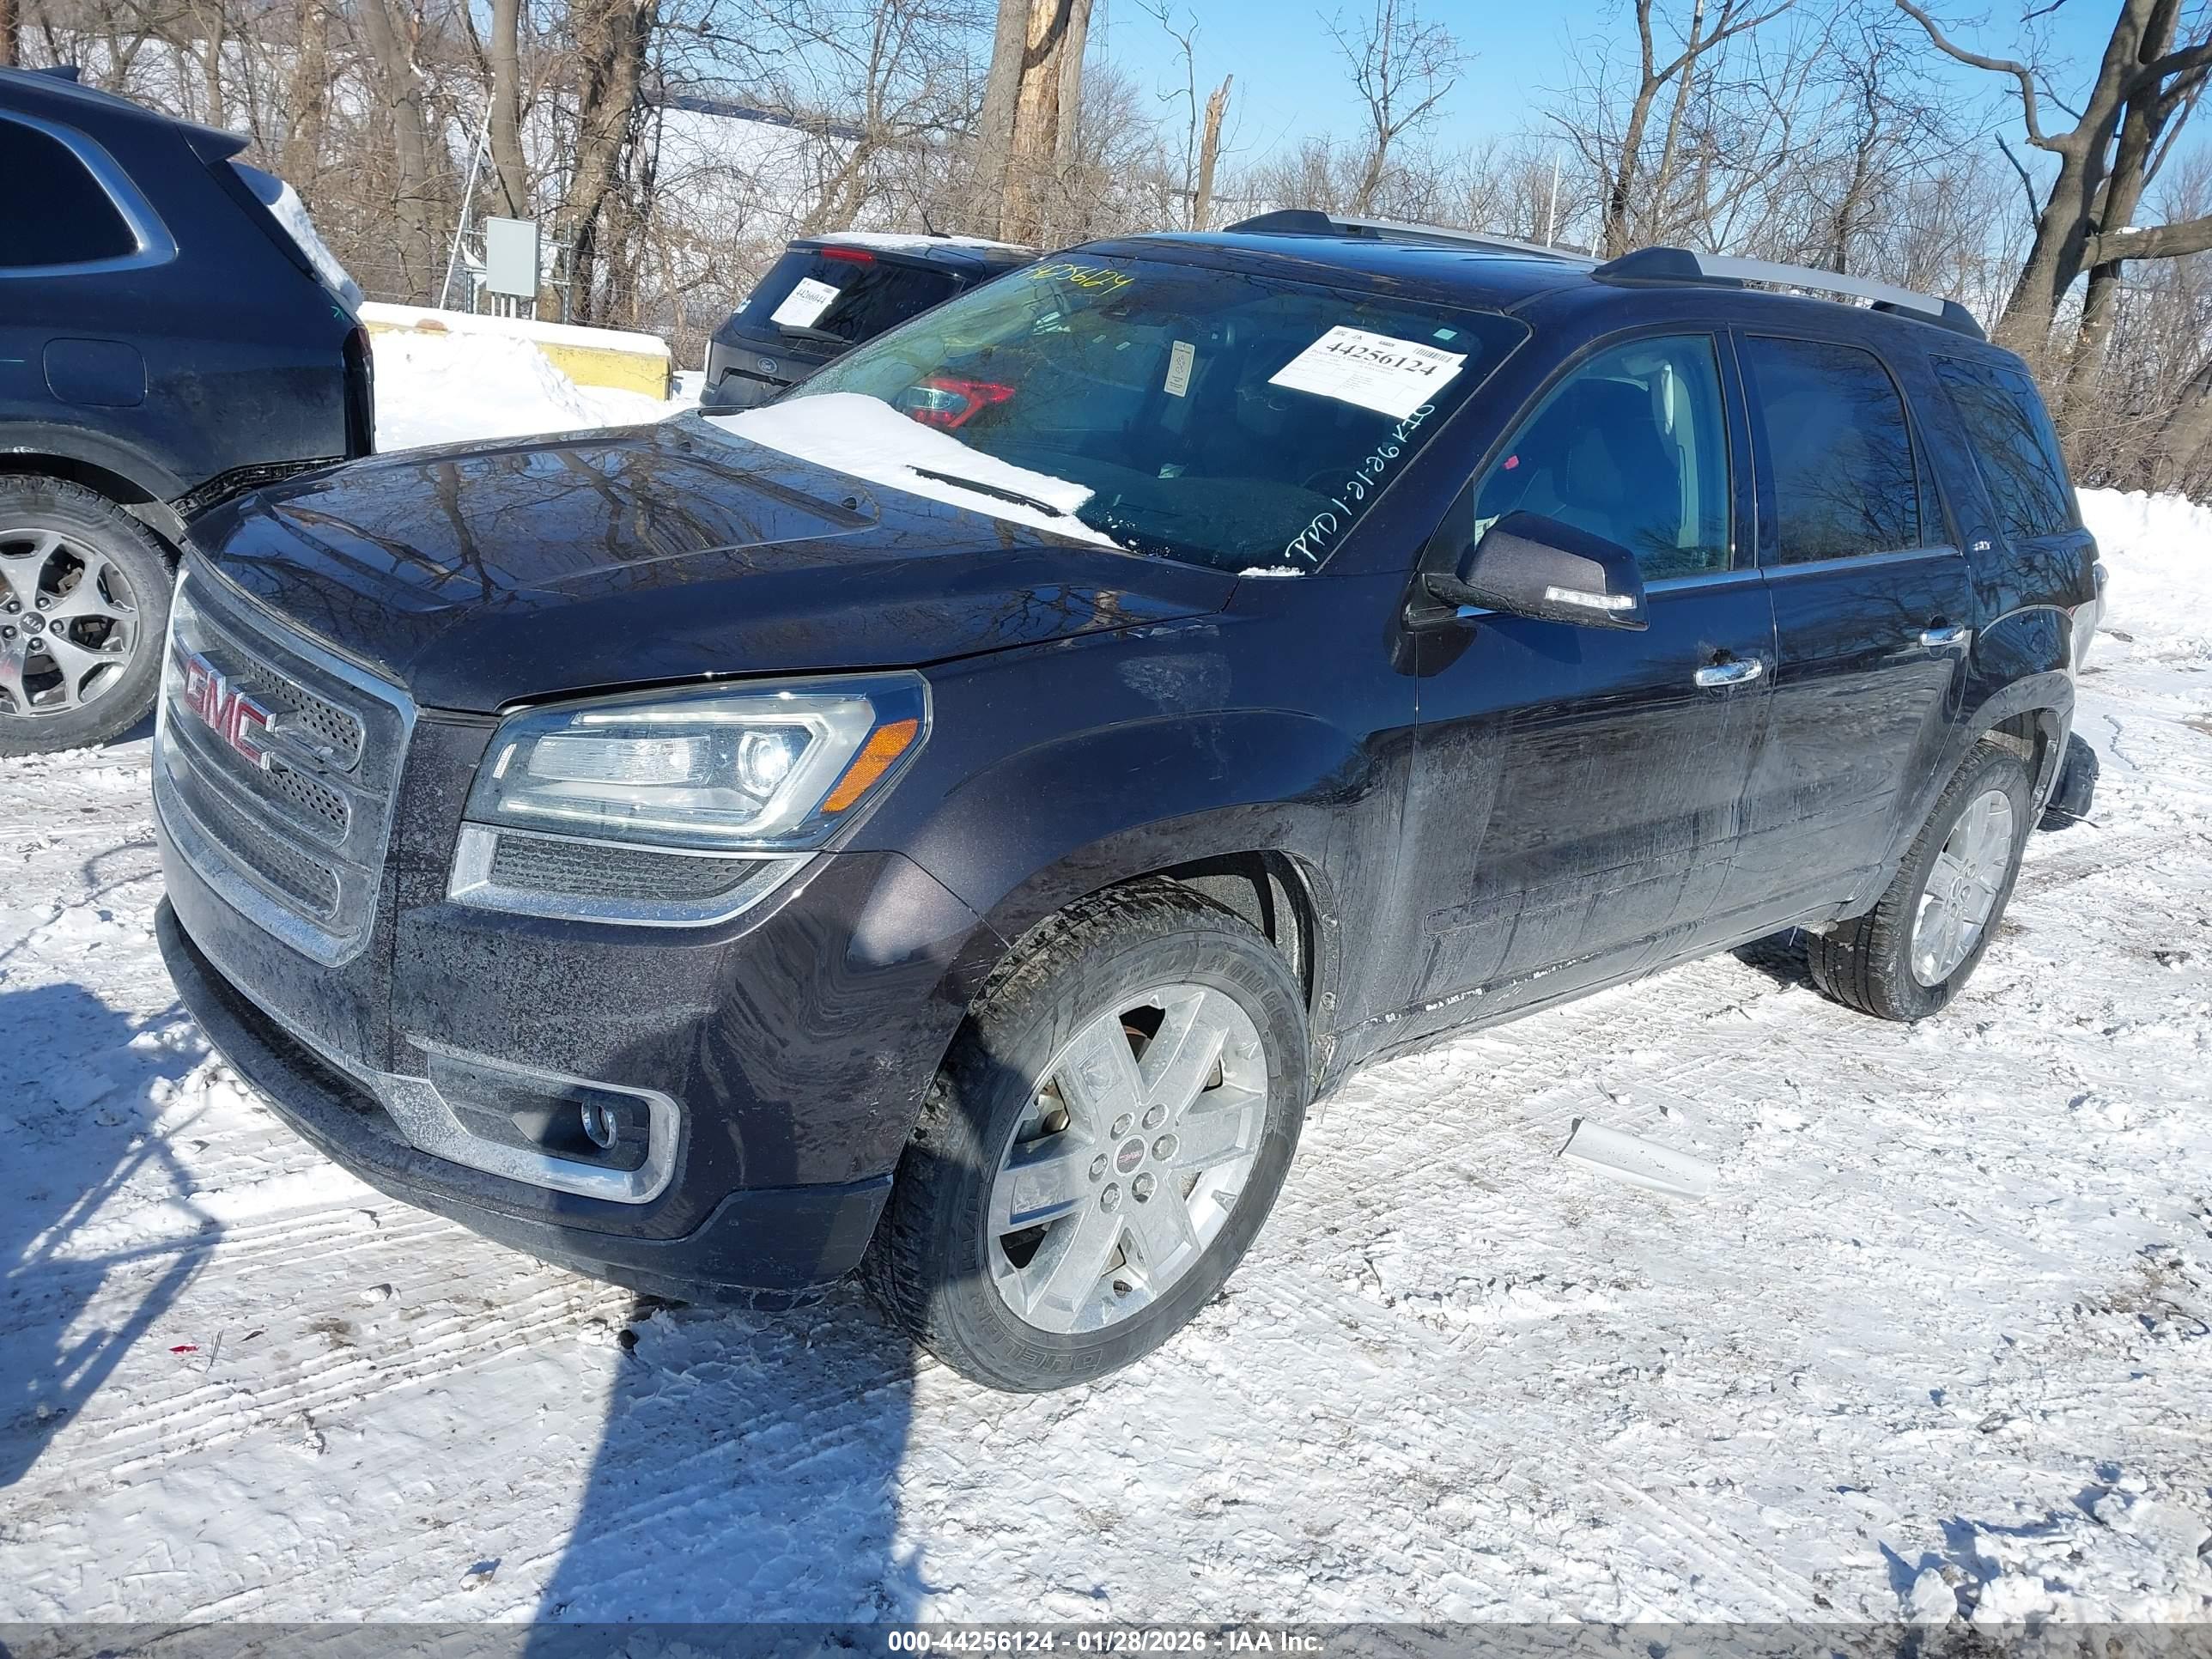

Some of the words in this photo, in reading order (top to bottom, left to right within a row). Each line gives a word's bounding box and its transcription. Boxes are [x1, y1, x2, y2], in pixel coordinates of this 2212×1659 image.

[1326, 342, 1438, 376] 44256124
[1331, 446, 1400, 516] 1-21-26
[23, 615, 42, 631] KIA
[184, 653, 276, 770] GMC
